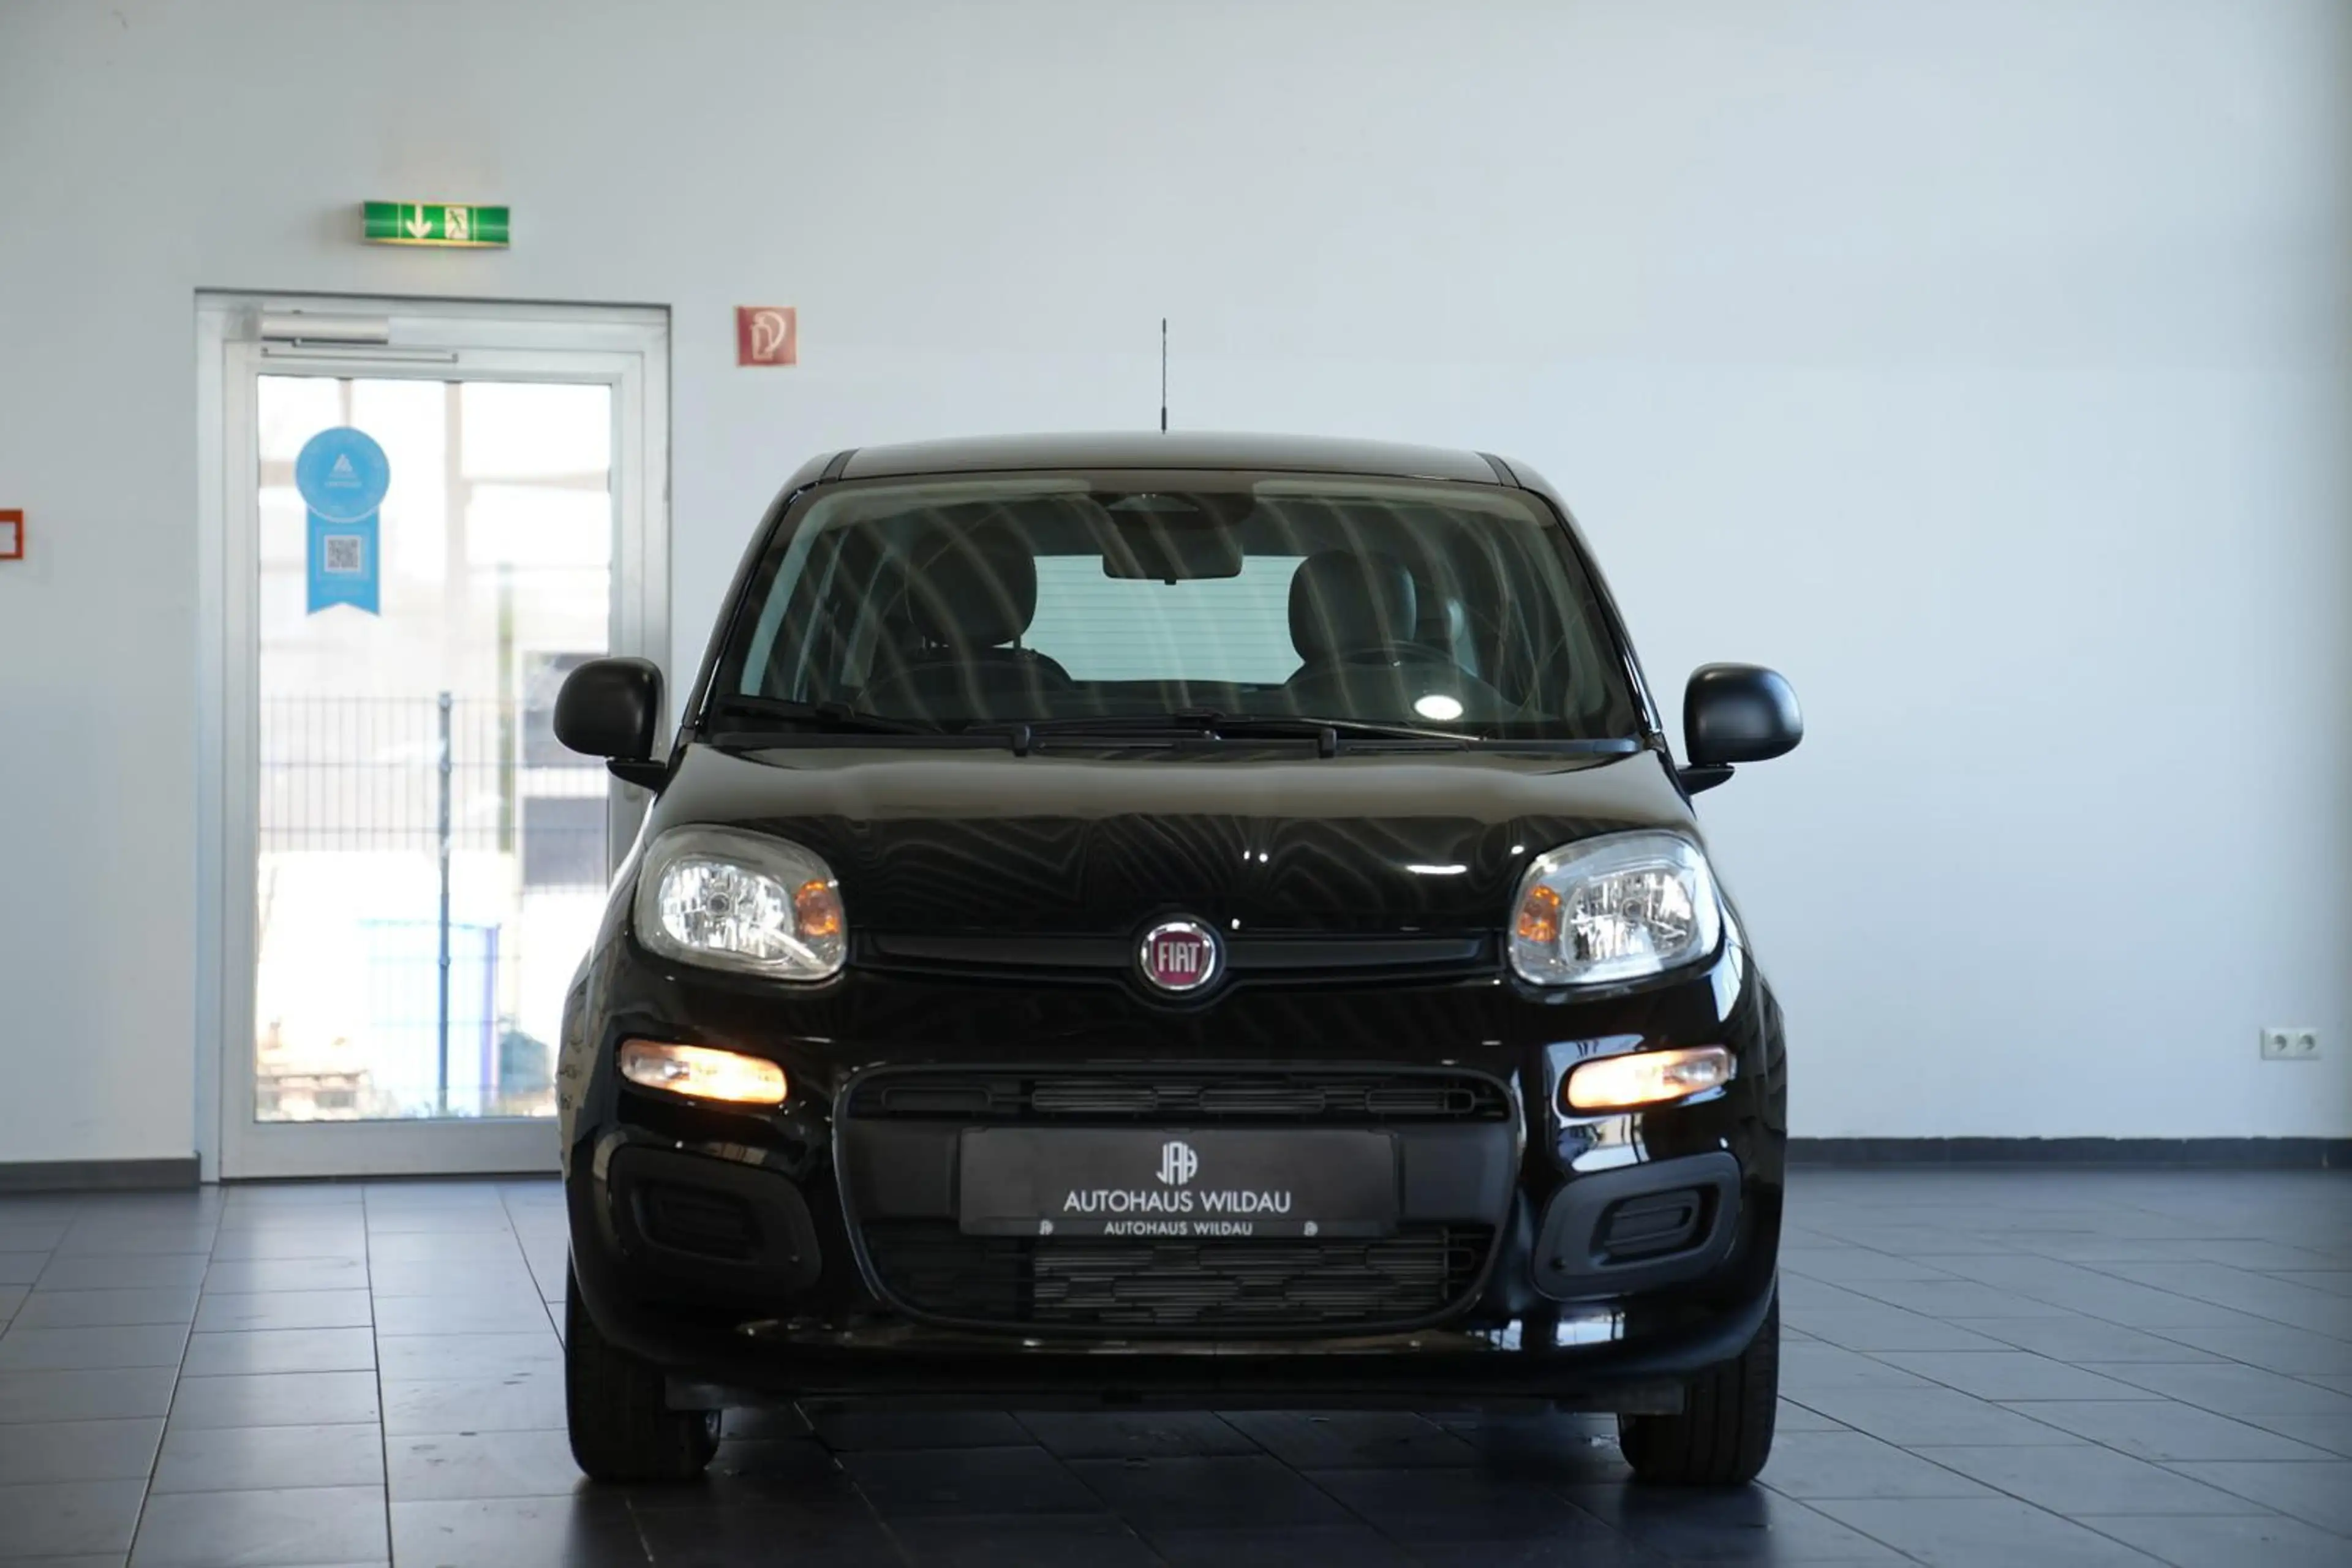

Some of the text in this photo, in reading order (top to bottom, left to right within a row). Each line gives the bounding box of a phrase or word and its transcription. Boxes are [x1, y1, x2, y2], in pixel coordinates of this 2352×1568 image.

[1158, 941, 1200, 973] FIAT
[1063, 1189, 1291, 1213] AUTOHAUS WILDAU
[1104, 1221, 1253, 1236] AUTOHAUS WILDAU
